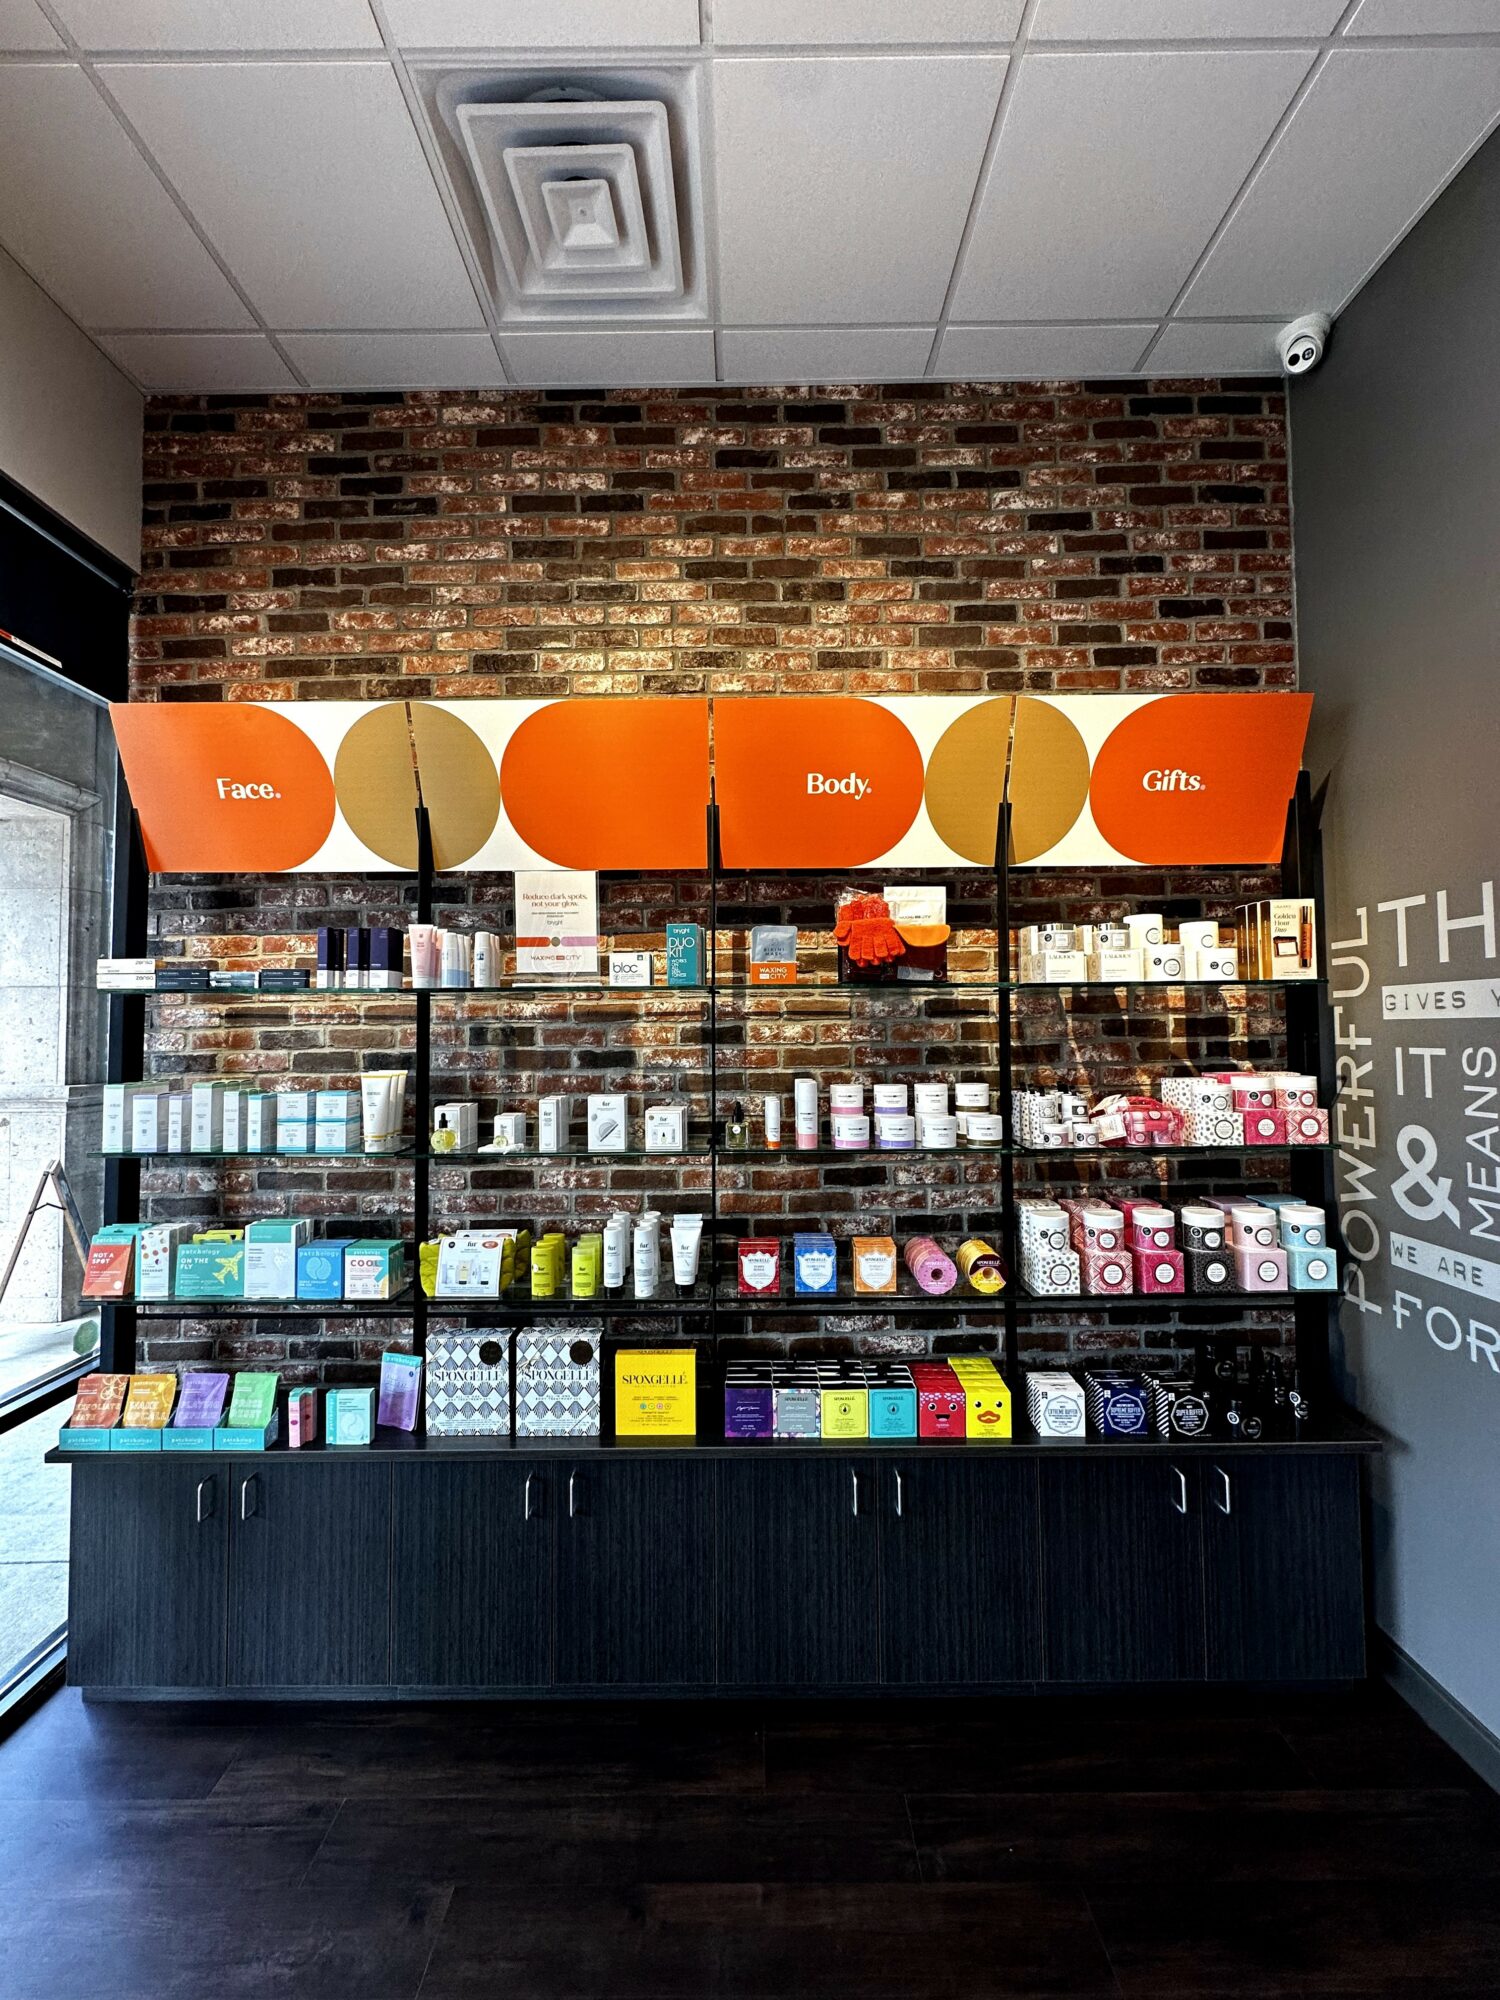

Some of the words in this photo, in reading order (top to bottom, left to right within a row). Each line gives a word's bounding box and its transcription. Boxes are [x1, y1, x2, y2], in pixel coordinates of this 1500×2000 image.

[216, 778, 281, 799] Face.
[807, 772, 872, 800] Body.
[1142, 769, 1206, 791] Gifts.
[669, 937, 695, 948] DUO
[669, 947, 684, 957] KIT
[613, 962, 638, 973] bloc
[1384, 991, 1466, 1011] GIVES
[1395, 1047, 1446, 1098] IT
[1331, 907, 1382, 1315] POWERFUL
[1461, 1047, 1500, 1241] MEANS
[1391, 1124, 1461, 1230] &
[350, 1259, 381, 1267] COOL
[1391, 1240, 1418, 1264] WE
[1437, 1257, 1483, 1287] ARE
[1392, 1289, 1500, 1373] FOR
[622, 1369, 688, 1384] SPONGELLÉ
